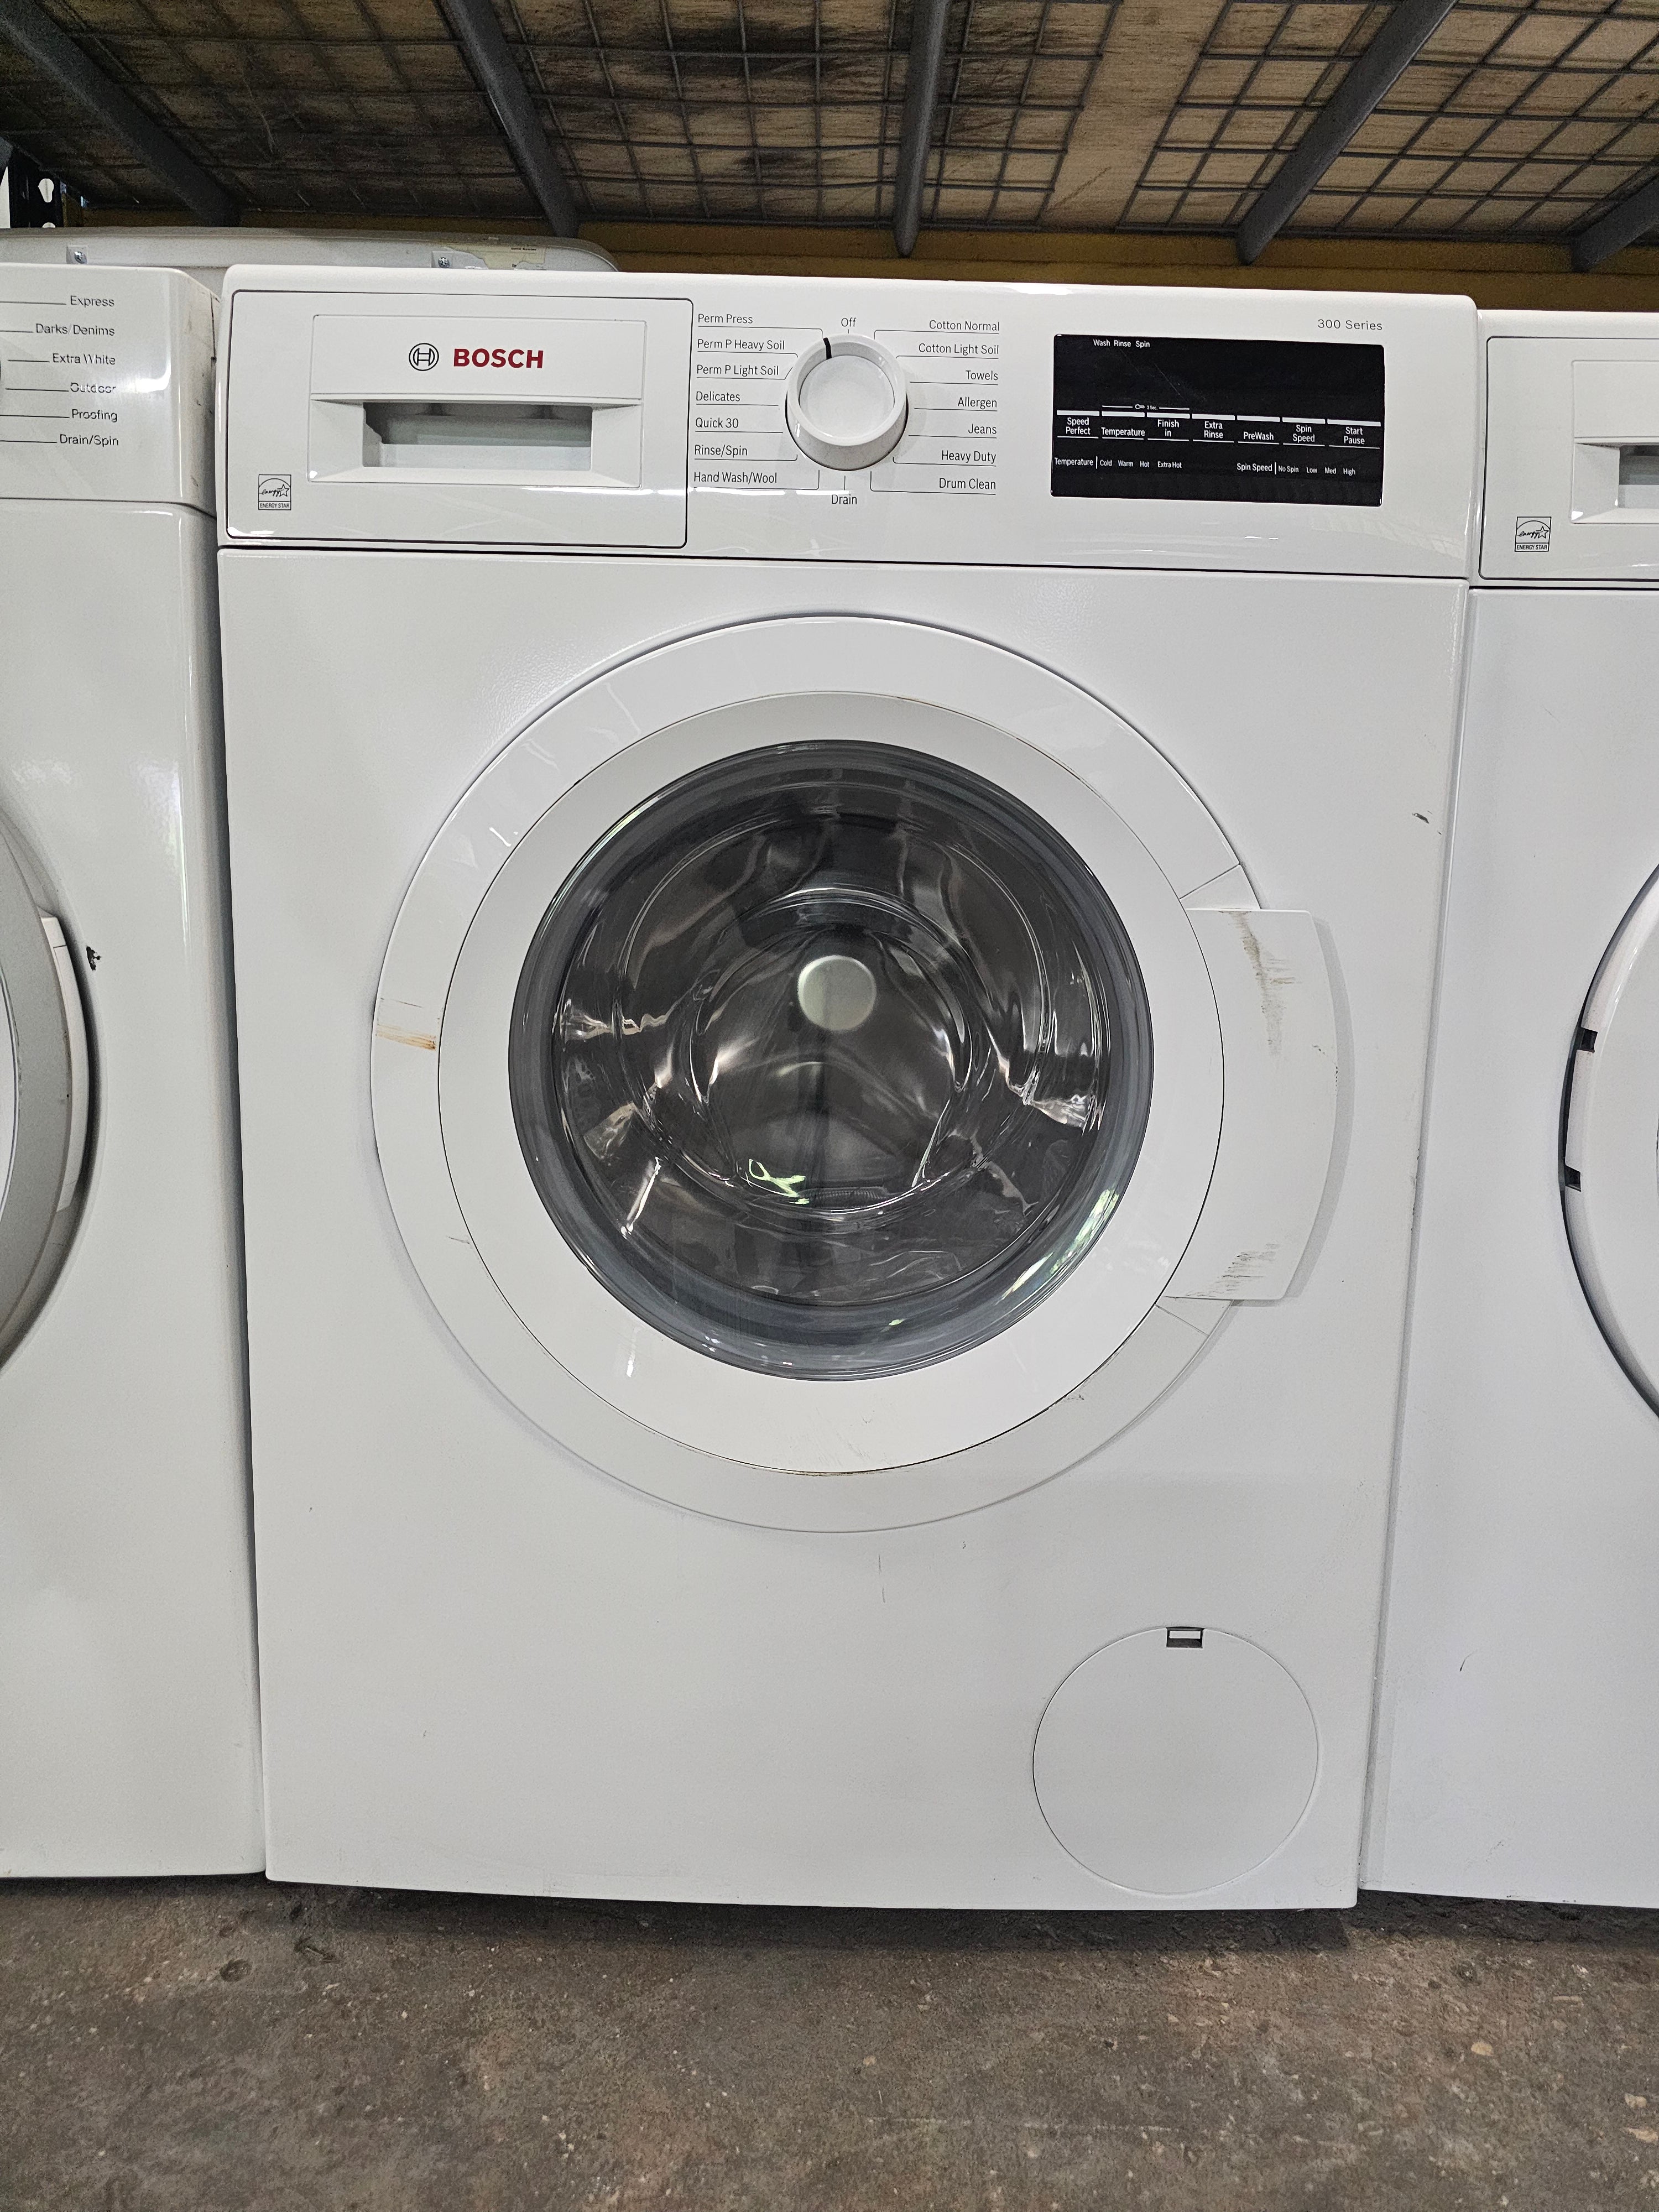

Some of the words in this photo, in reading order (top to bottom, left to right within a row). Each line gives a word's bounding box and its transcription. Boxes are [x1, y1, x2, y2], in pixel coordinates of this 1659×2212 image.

[70, 295, 114, 308] Express
[698, 314, 723, 324] Perm
[726, 314, 753, 324] Press
[841, 317, 856, 327] Off
[36, 323, 115, 336] Darks/Denims
[929, 320, 962, 331] Cotton
[964, 321, 1000, 332] Normal
[1317, 319, 1340, 329] 300
[1345, 320, 1383, 331] Series
[697, 339, 722, 349] Perm
[725, 340, 732, 349] P
[734, 340, 764, 352] Heavy
[767, 340, 785, 350] Soil
[1093, 338, 1110, 347] Wash
[1114, 340, 1131, 348] Rinse
[1135, 340, 1150, 349] Spin
[919, 343, 952, 354] Cotton
[954, 344, 978, 356] Light
[980, 345, 999, 354] Soil
[53, 353, 81, 363] Extra
[83, 353, 116, 365] White
[453, 348, 544, 368] BOSCH
[697, 365, 722, 375] Perm
[724, 366, 731, 375] P
[734, 366, 758, 377] Light
[761, 366, 779, 375] Soil
[966, 371, 998, 380] Towels
[70, 382, 116, 393] Outdoor
[696, 392, 740, 401] Delicates
[958, 397, 997, 409] Allergen
[72, 409, 118, 422] Proofing
[695, 418, 723, 428] Quick
[725, 419, 739, 429] 30
[1066, 417, 1089, 427] Speed
[1157, 419, 1179, 428] Finish
[1204, 421, 1223, 430] Extra
[968, 424, 997, 435] Jeans
[1065, 426, 1091, 436] Perfect
[1101, 427, 1146, 438] Temperature
[1165, 429, 1172, 437] in
[1203, 430, 1223, 439] Rinse
[1296, 424, 1312, 435] Spin
[1345, 426, 1363, 436] Start
[60, 434, 119, 447] Drain/Spin
[1243, 431, 1274, 441] PreWash
[1292, 434, 1315, 444] Speed
[1343, 436, 1365, 446] Pause
[695, 445, 748, 457] Rinse/Spin
[941, 451, 970, 463] Heavy
[973, 452, 997, 463] Duty
[1054, 457, 1094, 468] Temperature
[1099, 459, 1113, 468] Cold
[1118, 459, 1134, 468] Warm
[1139, 460, 1150, 468] Hot
[1157, 460, 1171, 469] Extra
[1172, 461, 1182, 469] Hot
[1237, 462, 1250, 472] Spin
[1252, 463, 1272, 473] Speed
[1287, 466, 1299, 474] Spin
[1343, 467, 1356, 477] High
[693, 472, 719, 483] Hand
[722, 473, 777, 484] Wash/Wool
[939, 478, 966, 489] Drum
[969, 478, 996, 490] Clean
[831, 494, 858, 505] Drain
